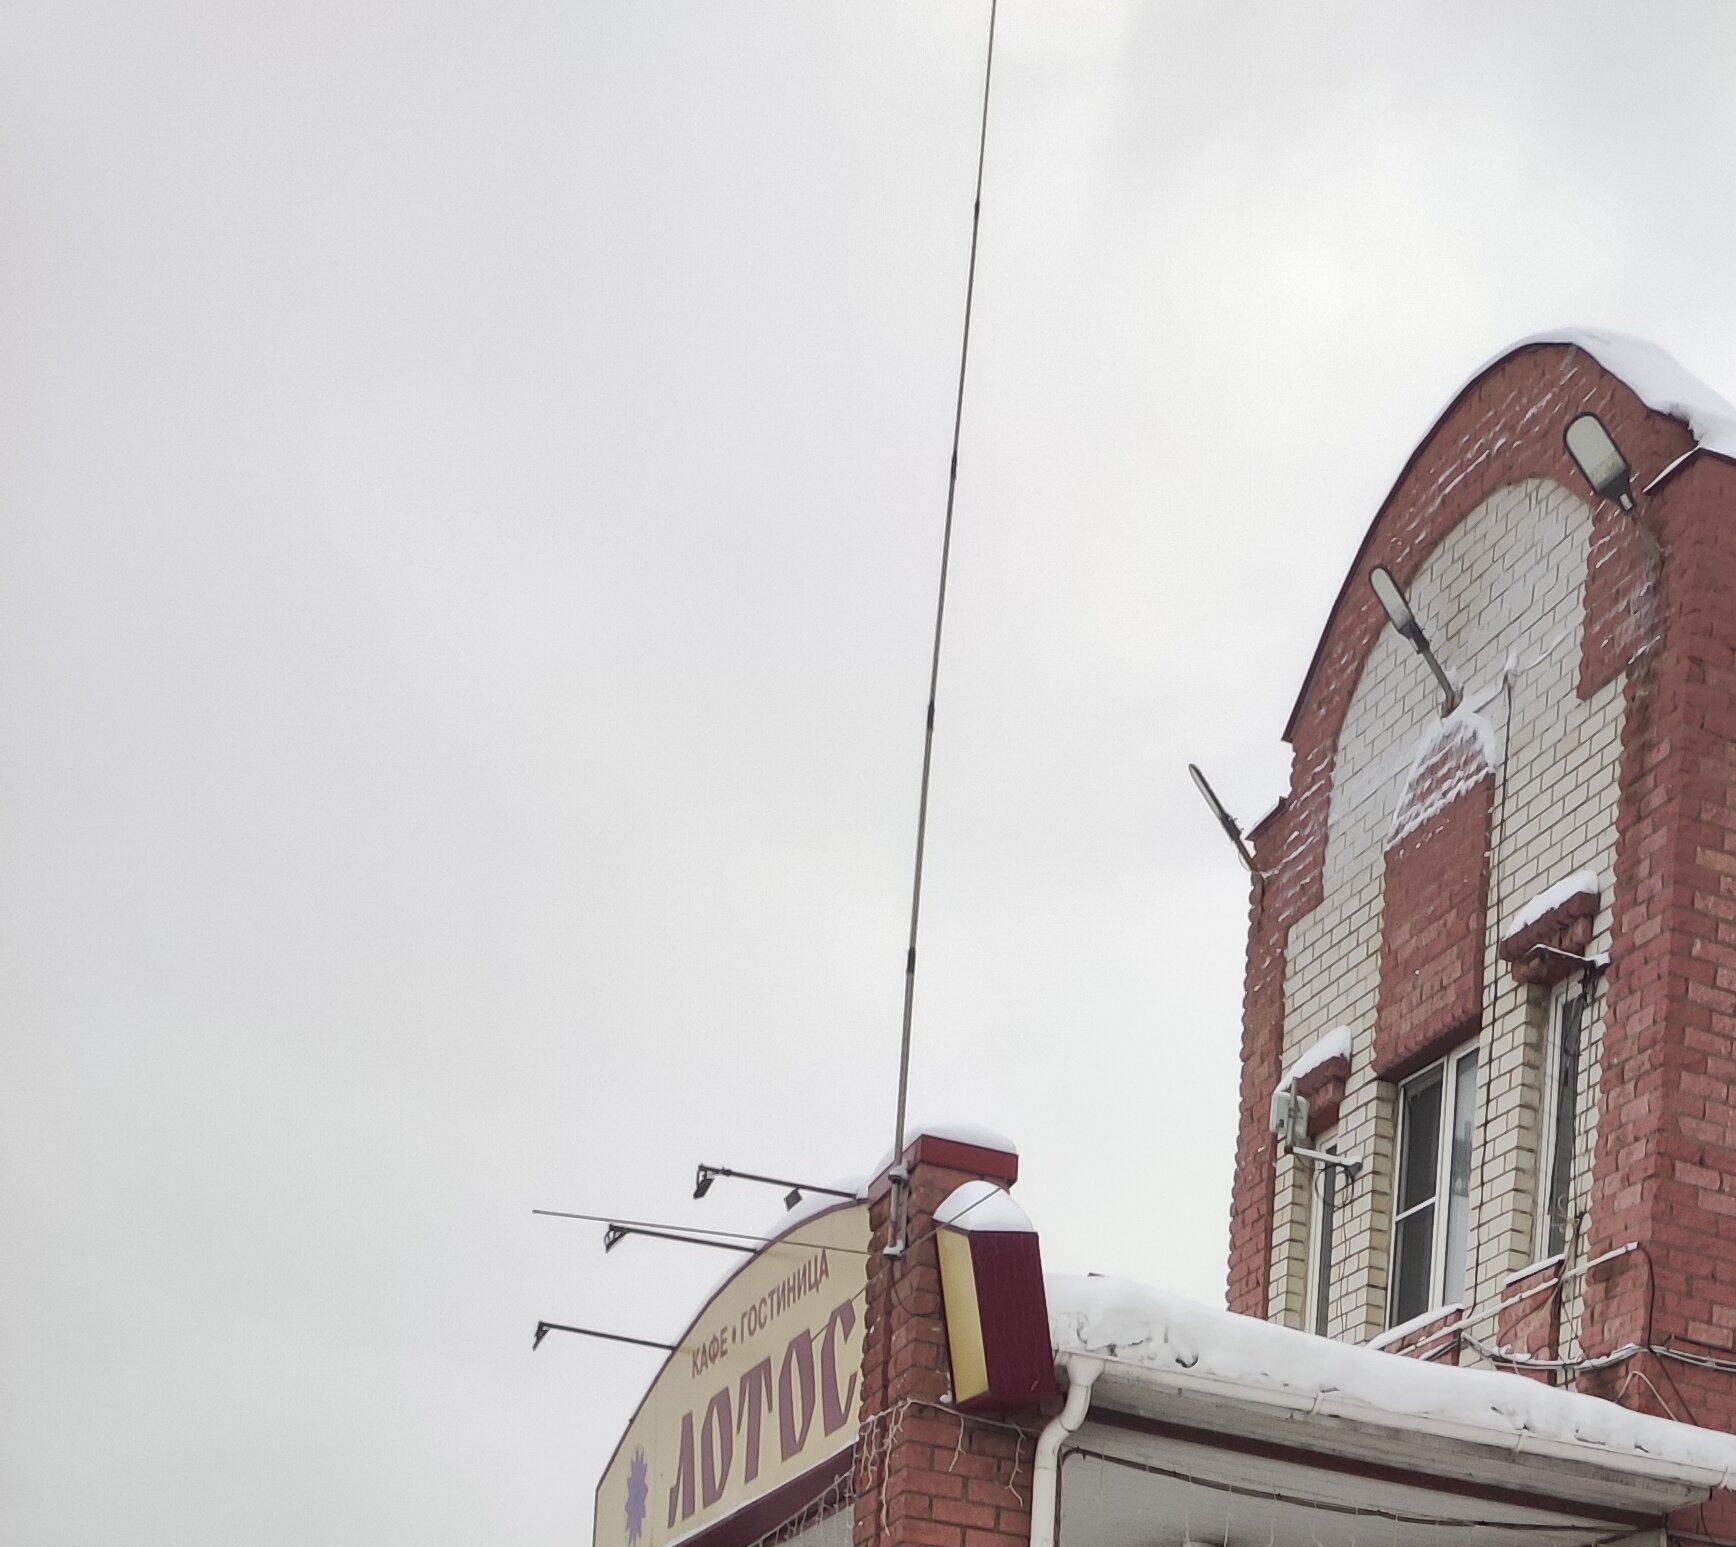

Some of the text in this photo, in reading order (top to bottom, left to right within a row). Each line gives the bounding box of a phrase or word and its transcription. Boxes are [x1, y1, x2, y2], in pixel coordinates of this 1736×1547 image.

[692, 1248, 830, 1379] КАФЕ ГОСТИНИЦА
[667, 1298, 858, 1530] ЛОТОС
